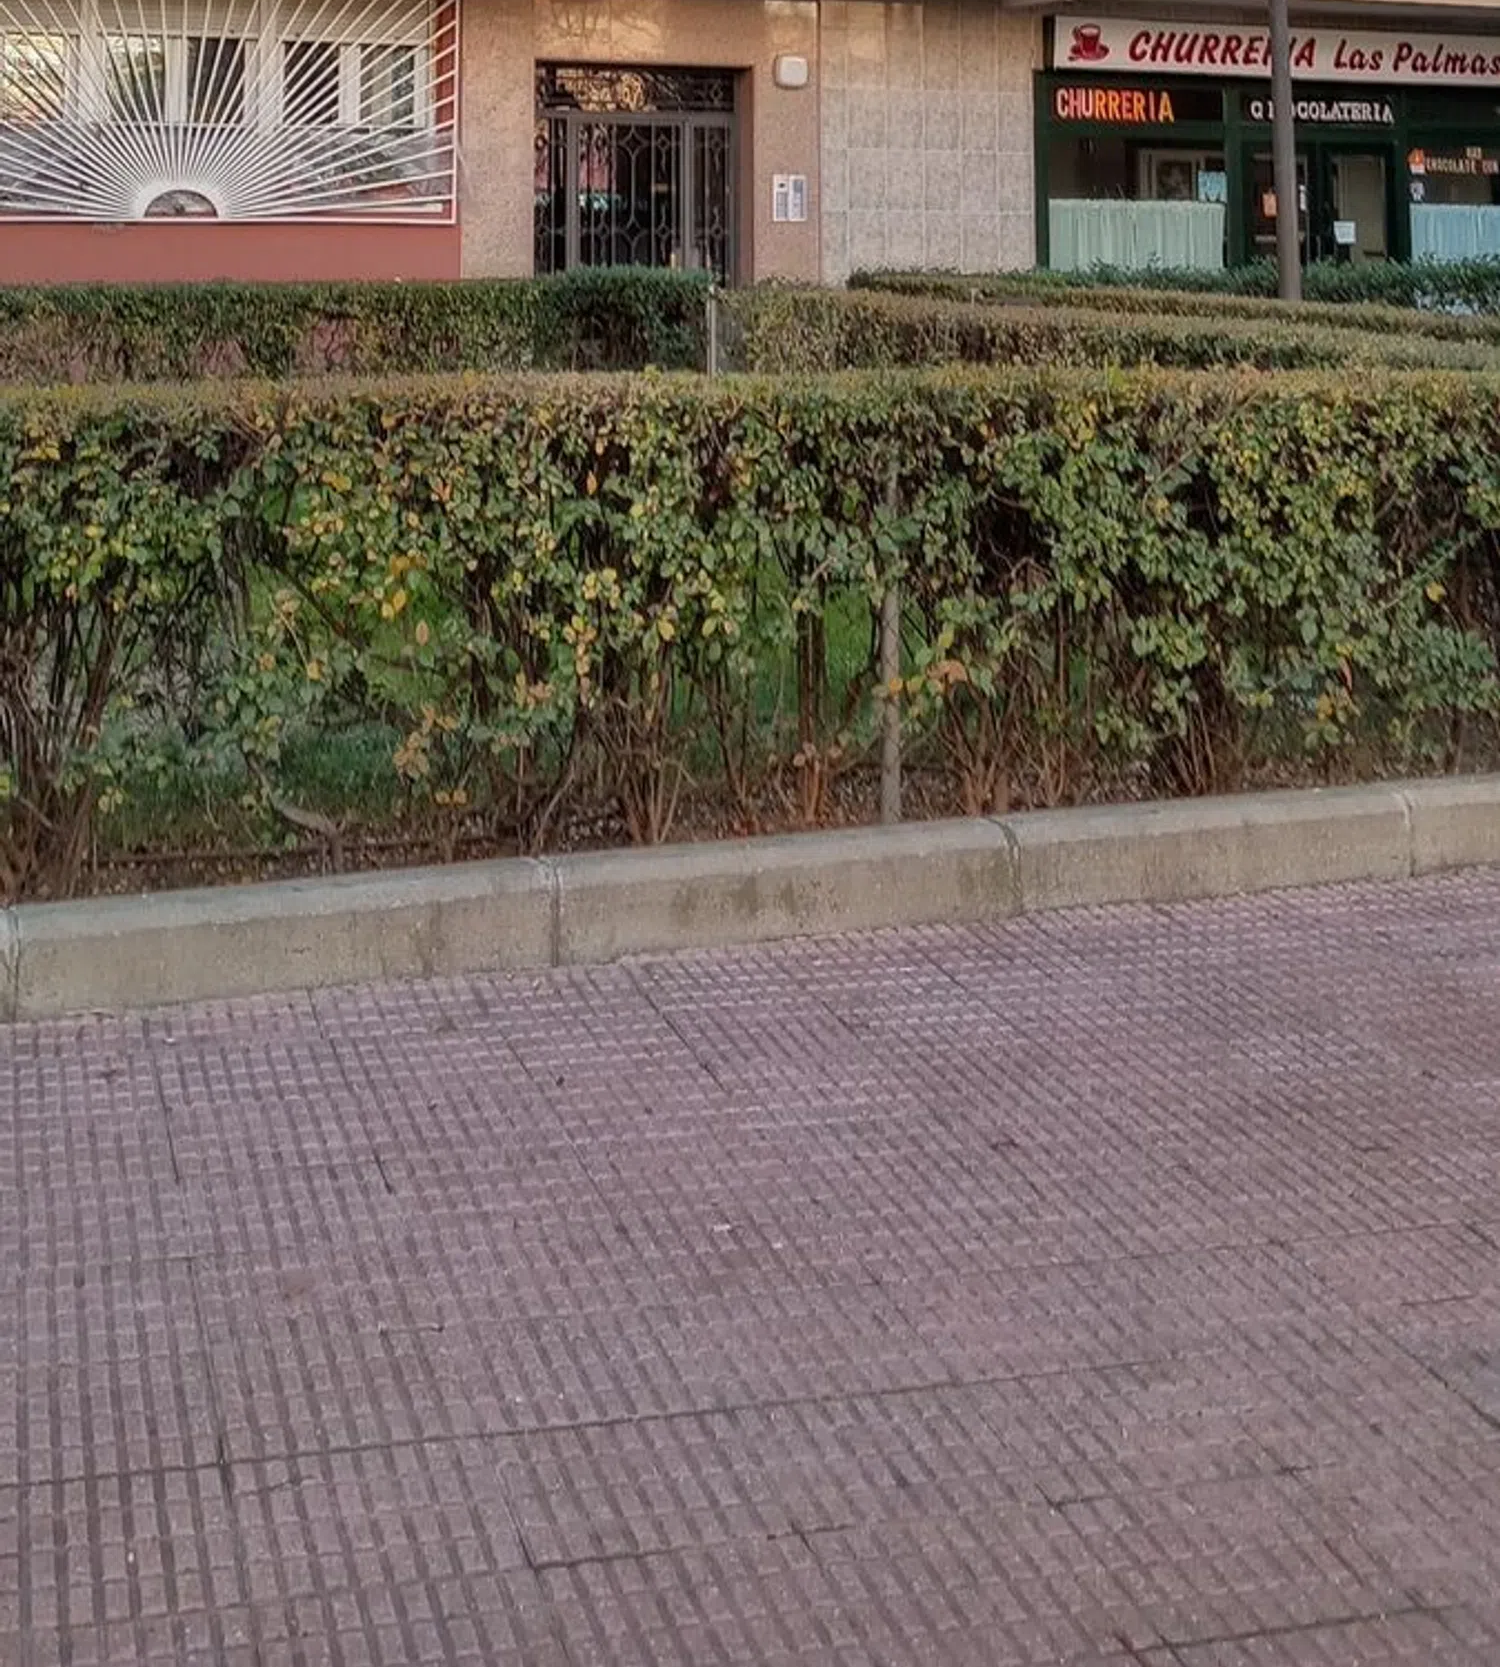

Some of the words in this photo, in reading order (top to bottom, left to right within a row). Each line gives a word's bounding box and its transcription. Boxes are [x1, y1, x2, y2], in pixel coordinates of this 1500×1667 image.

[1333, 37, 1383, 71] Las
[1392, 41, 1500, 75] Palmas
[1056, 87, 1175, 123] CHURRERIA
